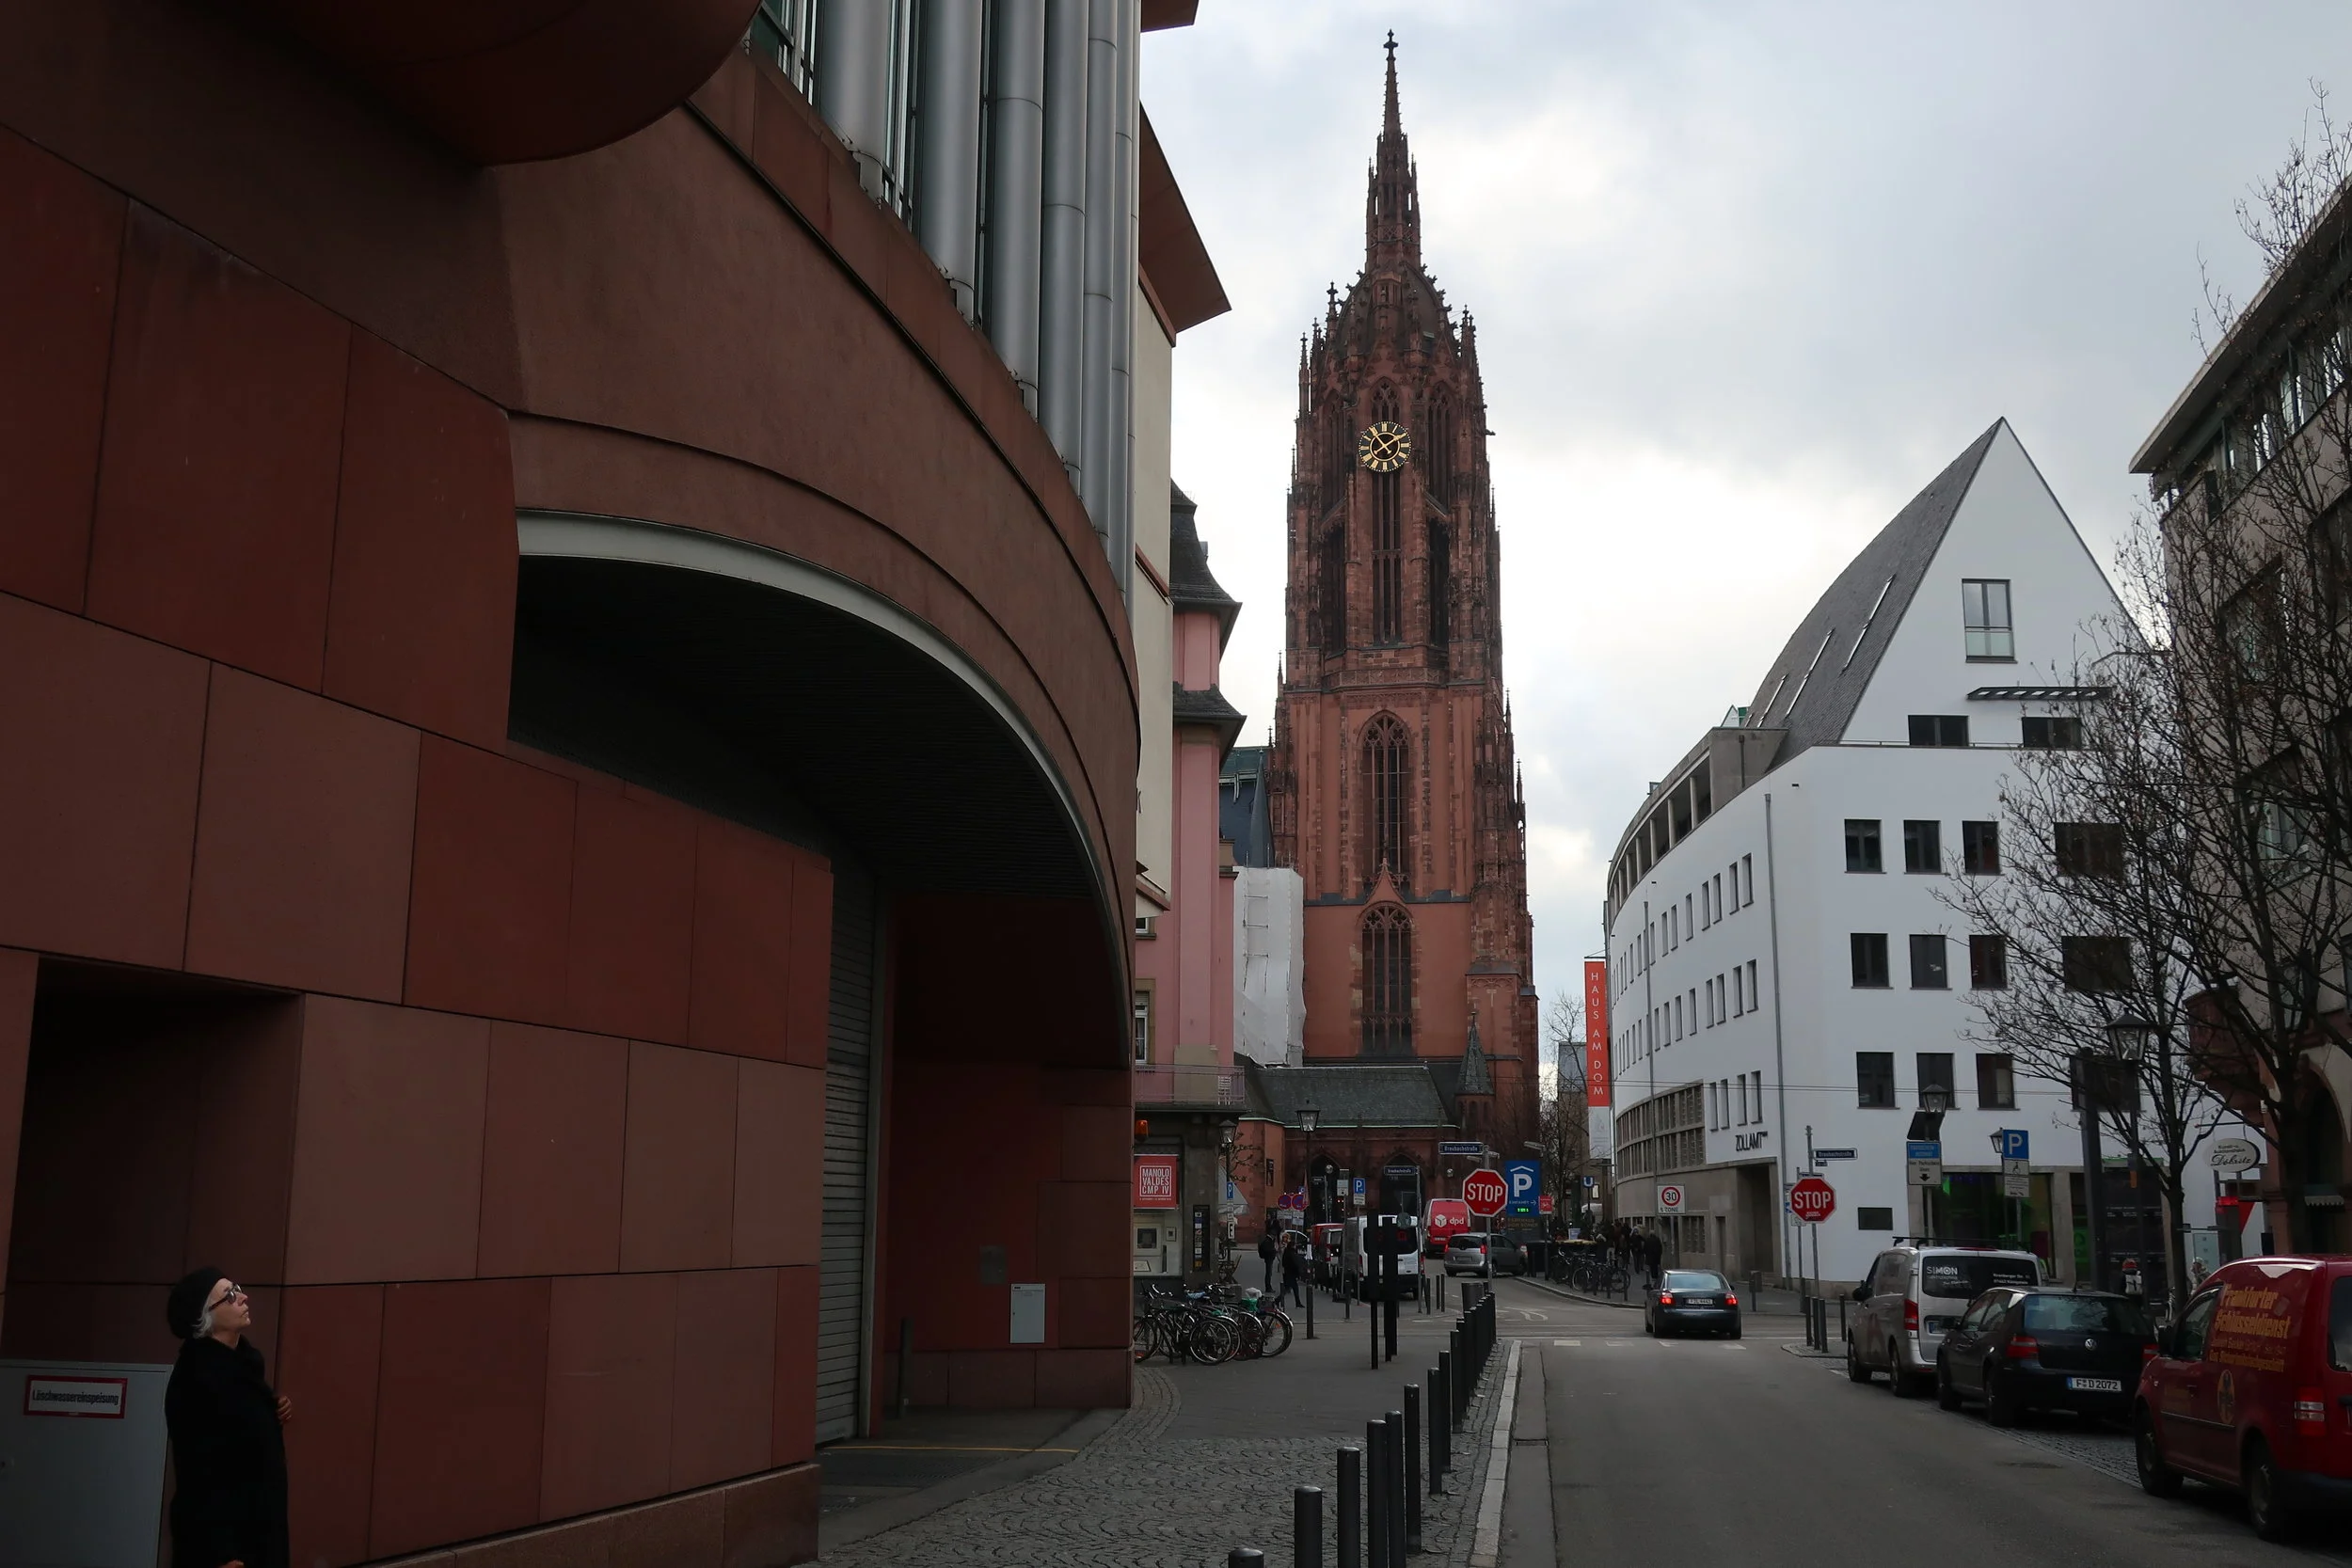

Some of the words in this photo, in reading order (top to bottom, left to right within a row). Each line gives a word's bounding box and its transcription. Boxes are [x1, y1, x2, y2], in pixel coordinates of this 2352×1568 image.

[1591, 973, 1599, 1020] HAUS
[1592, 1029, 1602, 1051] AM
[1593, 1060, 1603, 1095] DOM
[2008, 1133, 2023, 1155] P
[1141, 1168, 1169, 1177] MANOLO
[1141, 1177, 1169, 1185] VALDES
[1513, 1173, 1533, 1197] P
[1583, 1177, 1594, 1187] U
[1141, 1186, 1159, 1195] CMP
[1162, 1186, 1169, 1195] IV
[1467, 1183, 1503, 1202] STOP
[1665, 1192, 1677, 1201] 30
[1794, 1191, 1832, 1209] STOP
[1449, 1217, 1465, 1226] dpd
[1926, 1266, 1958, 1275] SIMON
